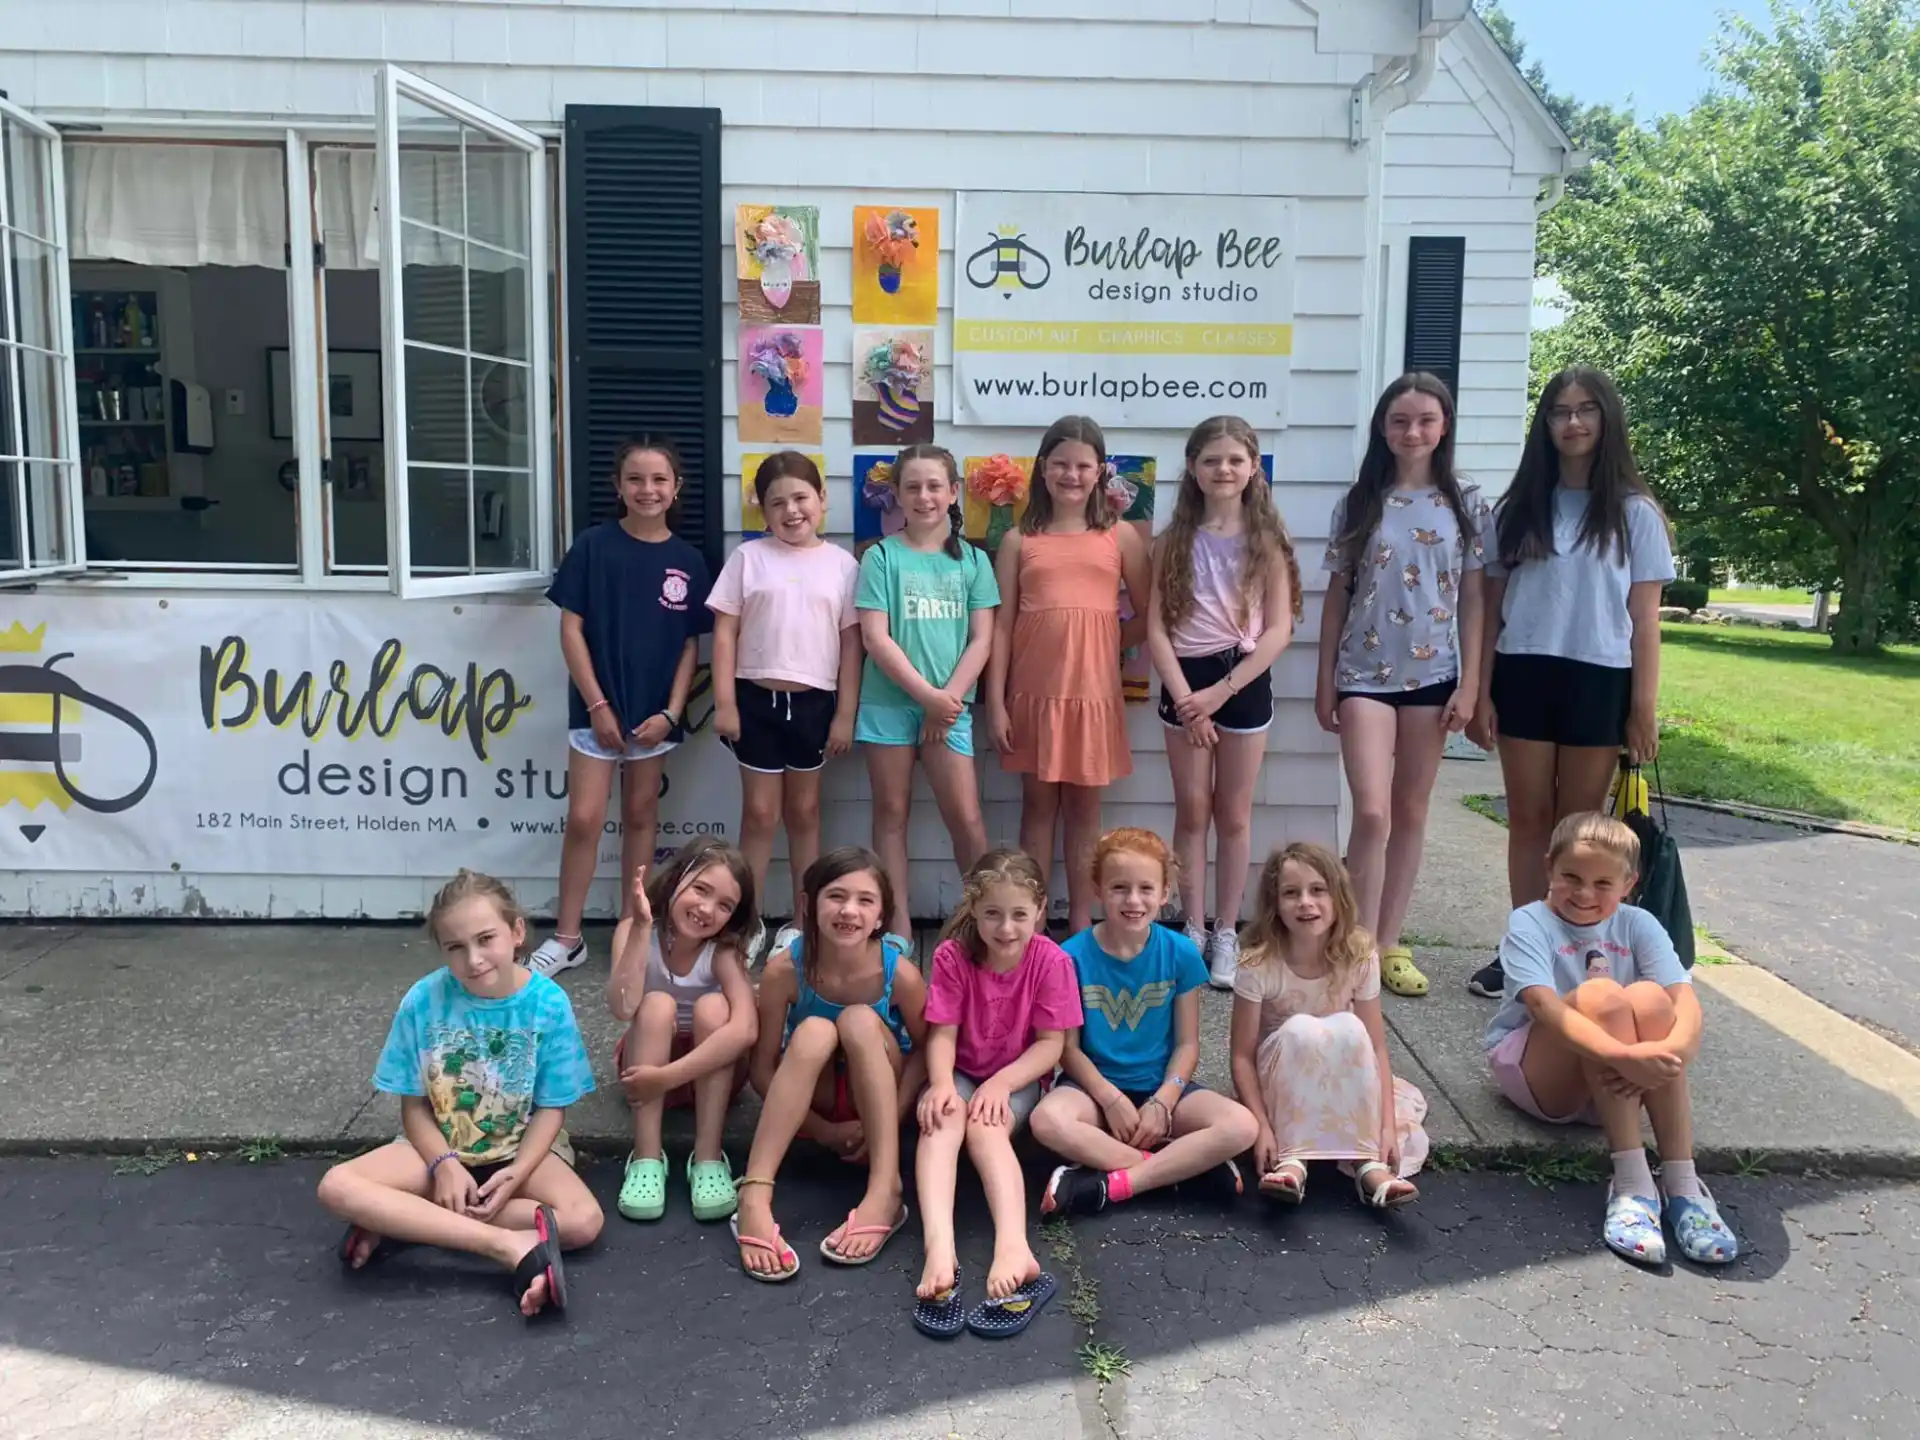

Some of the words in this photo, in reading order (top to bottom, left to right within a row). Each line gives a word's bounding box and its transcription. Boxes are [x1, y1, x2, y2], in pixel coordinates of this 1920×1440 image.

[1065, 225, 1203, 280] Burlap
[1216, 228, 1283, 270] Bee
[1088, 278, 1171, 304] design
[1181, 281, 1259, 303] studio
[968, 326, 1044, 343] CUSTOM
[1050, 327, 1081, 345] ART
[1098, 328, 1184, 346] GRAPHICS
[1201, 328, 1279, 347] CLASSES
[973, 371, 1268, 403] www.burlapbee.com
[903, 595, 964, 620] EARTH
[199, 635, 533, 763] Burlap
[277, 748, 468, 806] design
[196, 812, 232, 829] 182
[240, 812, 283, 830] Main
[290, 813, 350, 832] Street,
[357, 814, 421, 832] Holden
[427, 816, 457, 833] MA
